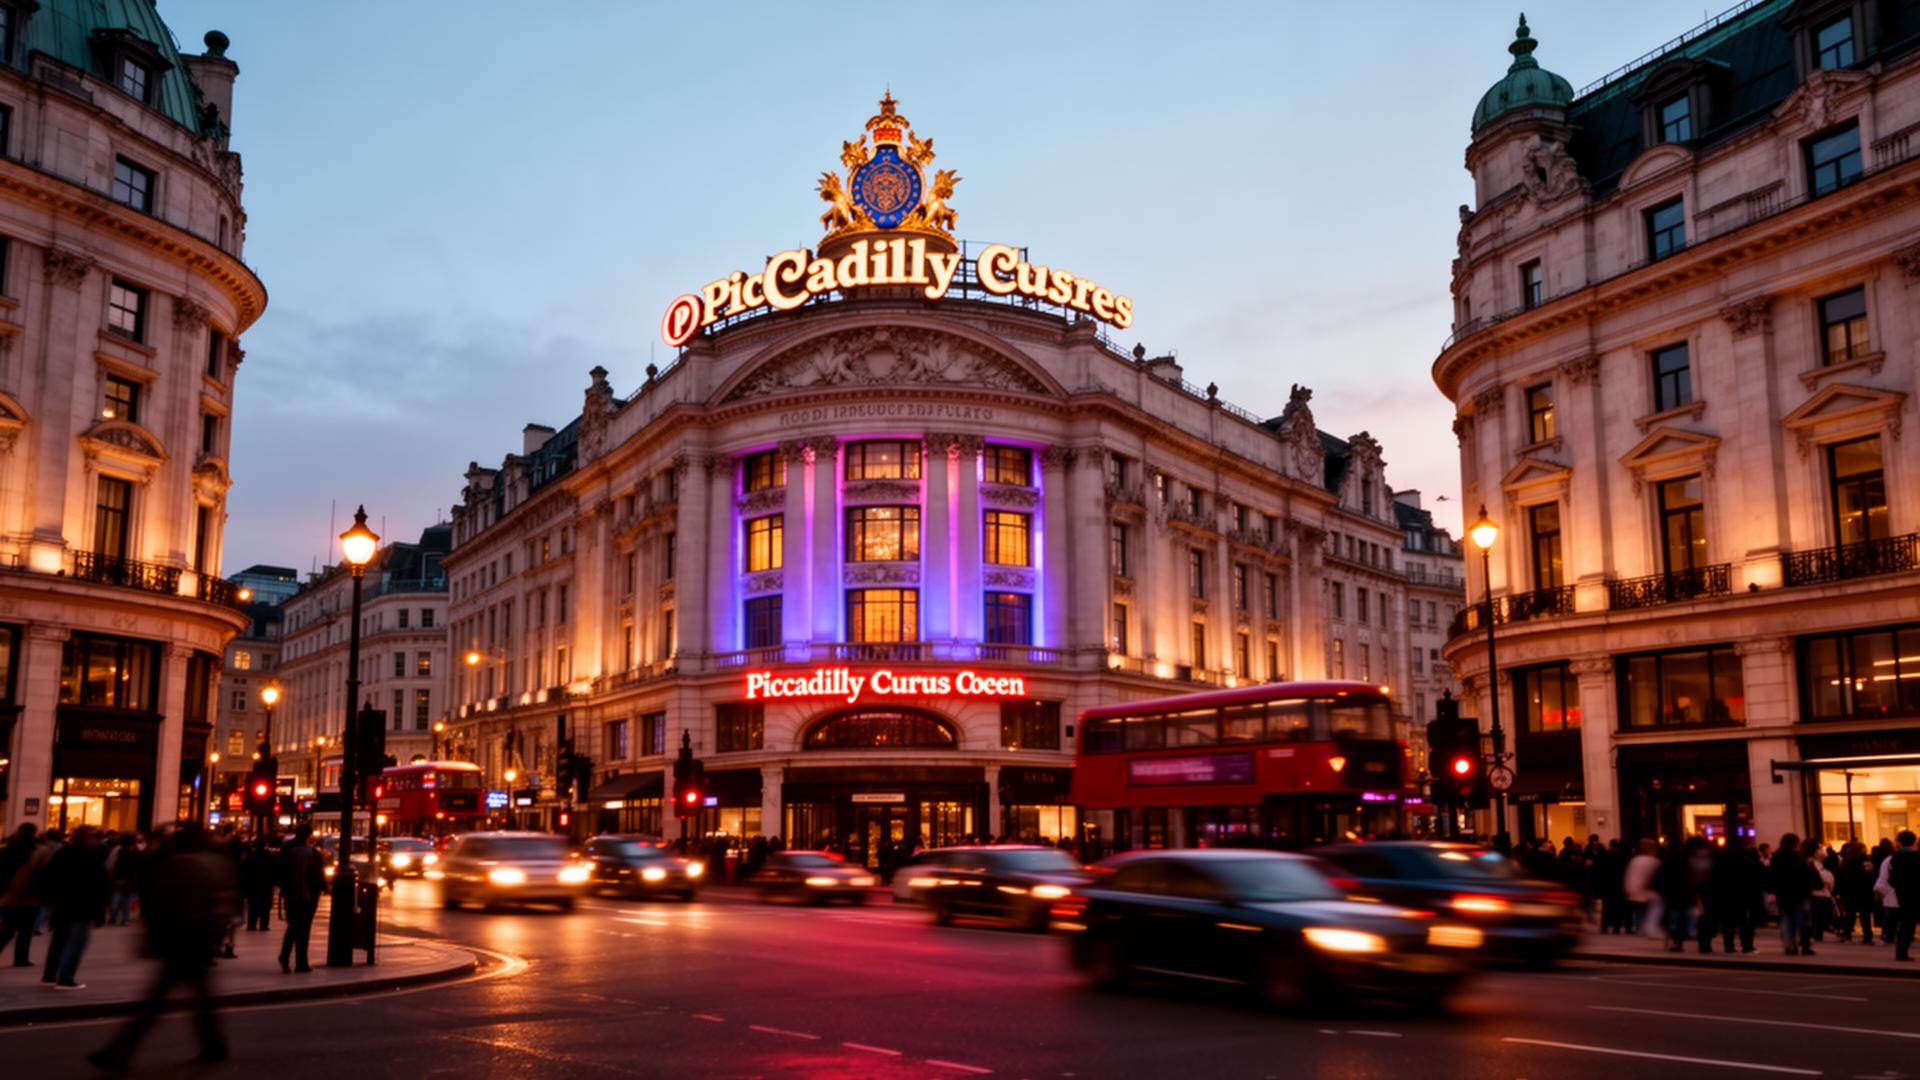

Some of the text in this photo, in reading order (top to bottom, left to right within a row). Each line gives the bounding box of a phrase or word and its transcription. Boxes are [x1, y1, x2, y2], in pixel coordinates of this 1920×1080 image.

[701, 238, 962, 326] PicCadilly
[977, 244, 1135, 328] Cusres
[746, 668, 865, 704] Piccadilly
[870, 670, 951, 695] Curus
